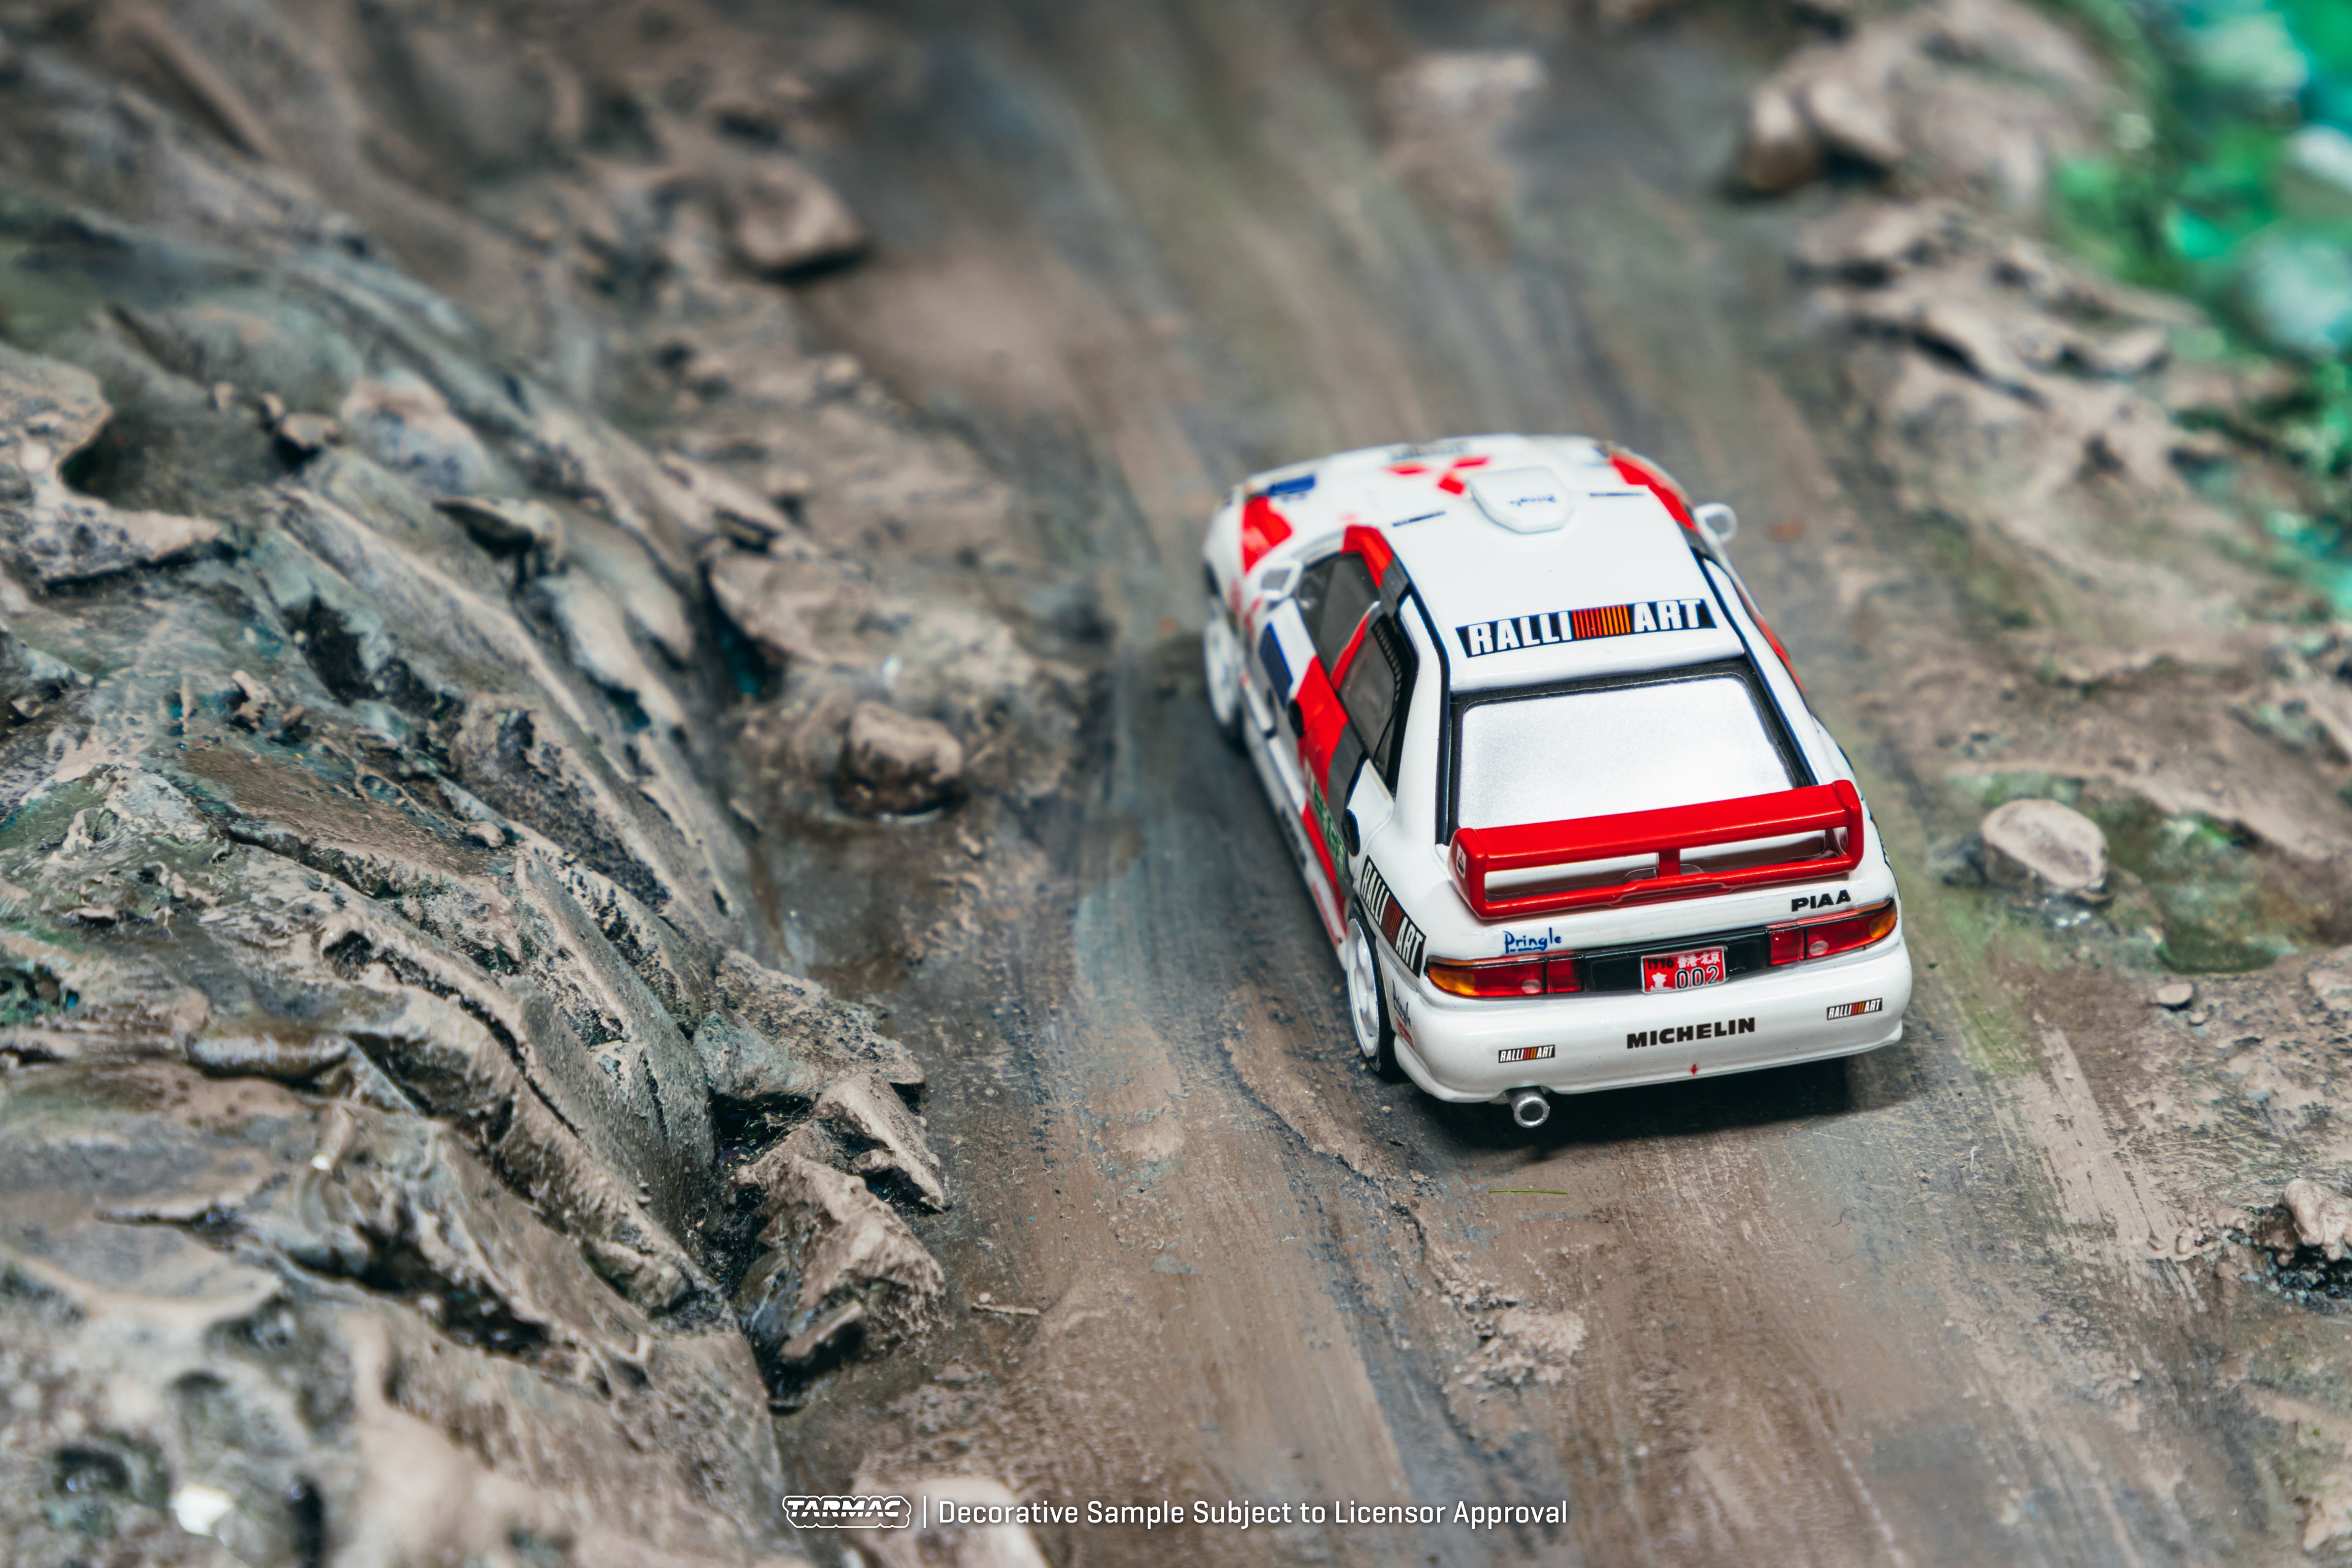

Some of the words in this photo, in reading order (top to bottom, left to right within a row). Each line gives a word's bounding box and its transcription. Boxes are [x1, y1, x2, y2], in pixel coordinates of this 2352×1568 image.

[1468, 611, 1572, 656] RALLI
[1634, 598, 1702, 633] ART
[1791, 889, 1852, 912] PIAA
[1360, 861, 1390, 927] RALLI
[1395, 916, 1423, 971] ART
[1502, 927, 1562, 954] Pringle
[1675, 965, 1720, 989] 002
[1828, 1003, 1852, 1019] RALLI
[1863, 998, 1881, 1013] ART
[1626, 1017, 1755, 1049] MICHELIN
[1499, 1049, 1525, 1062] RALLI
[1536, 1046, 1554, 1058] ART
